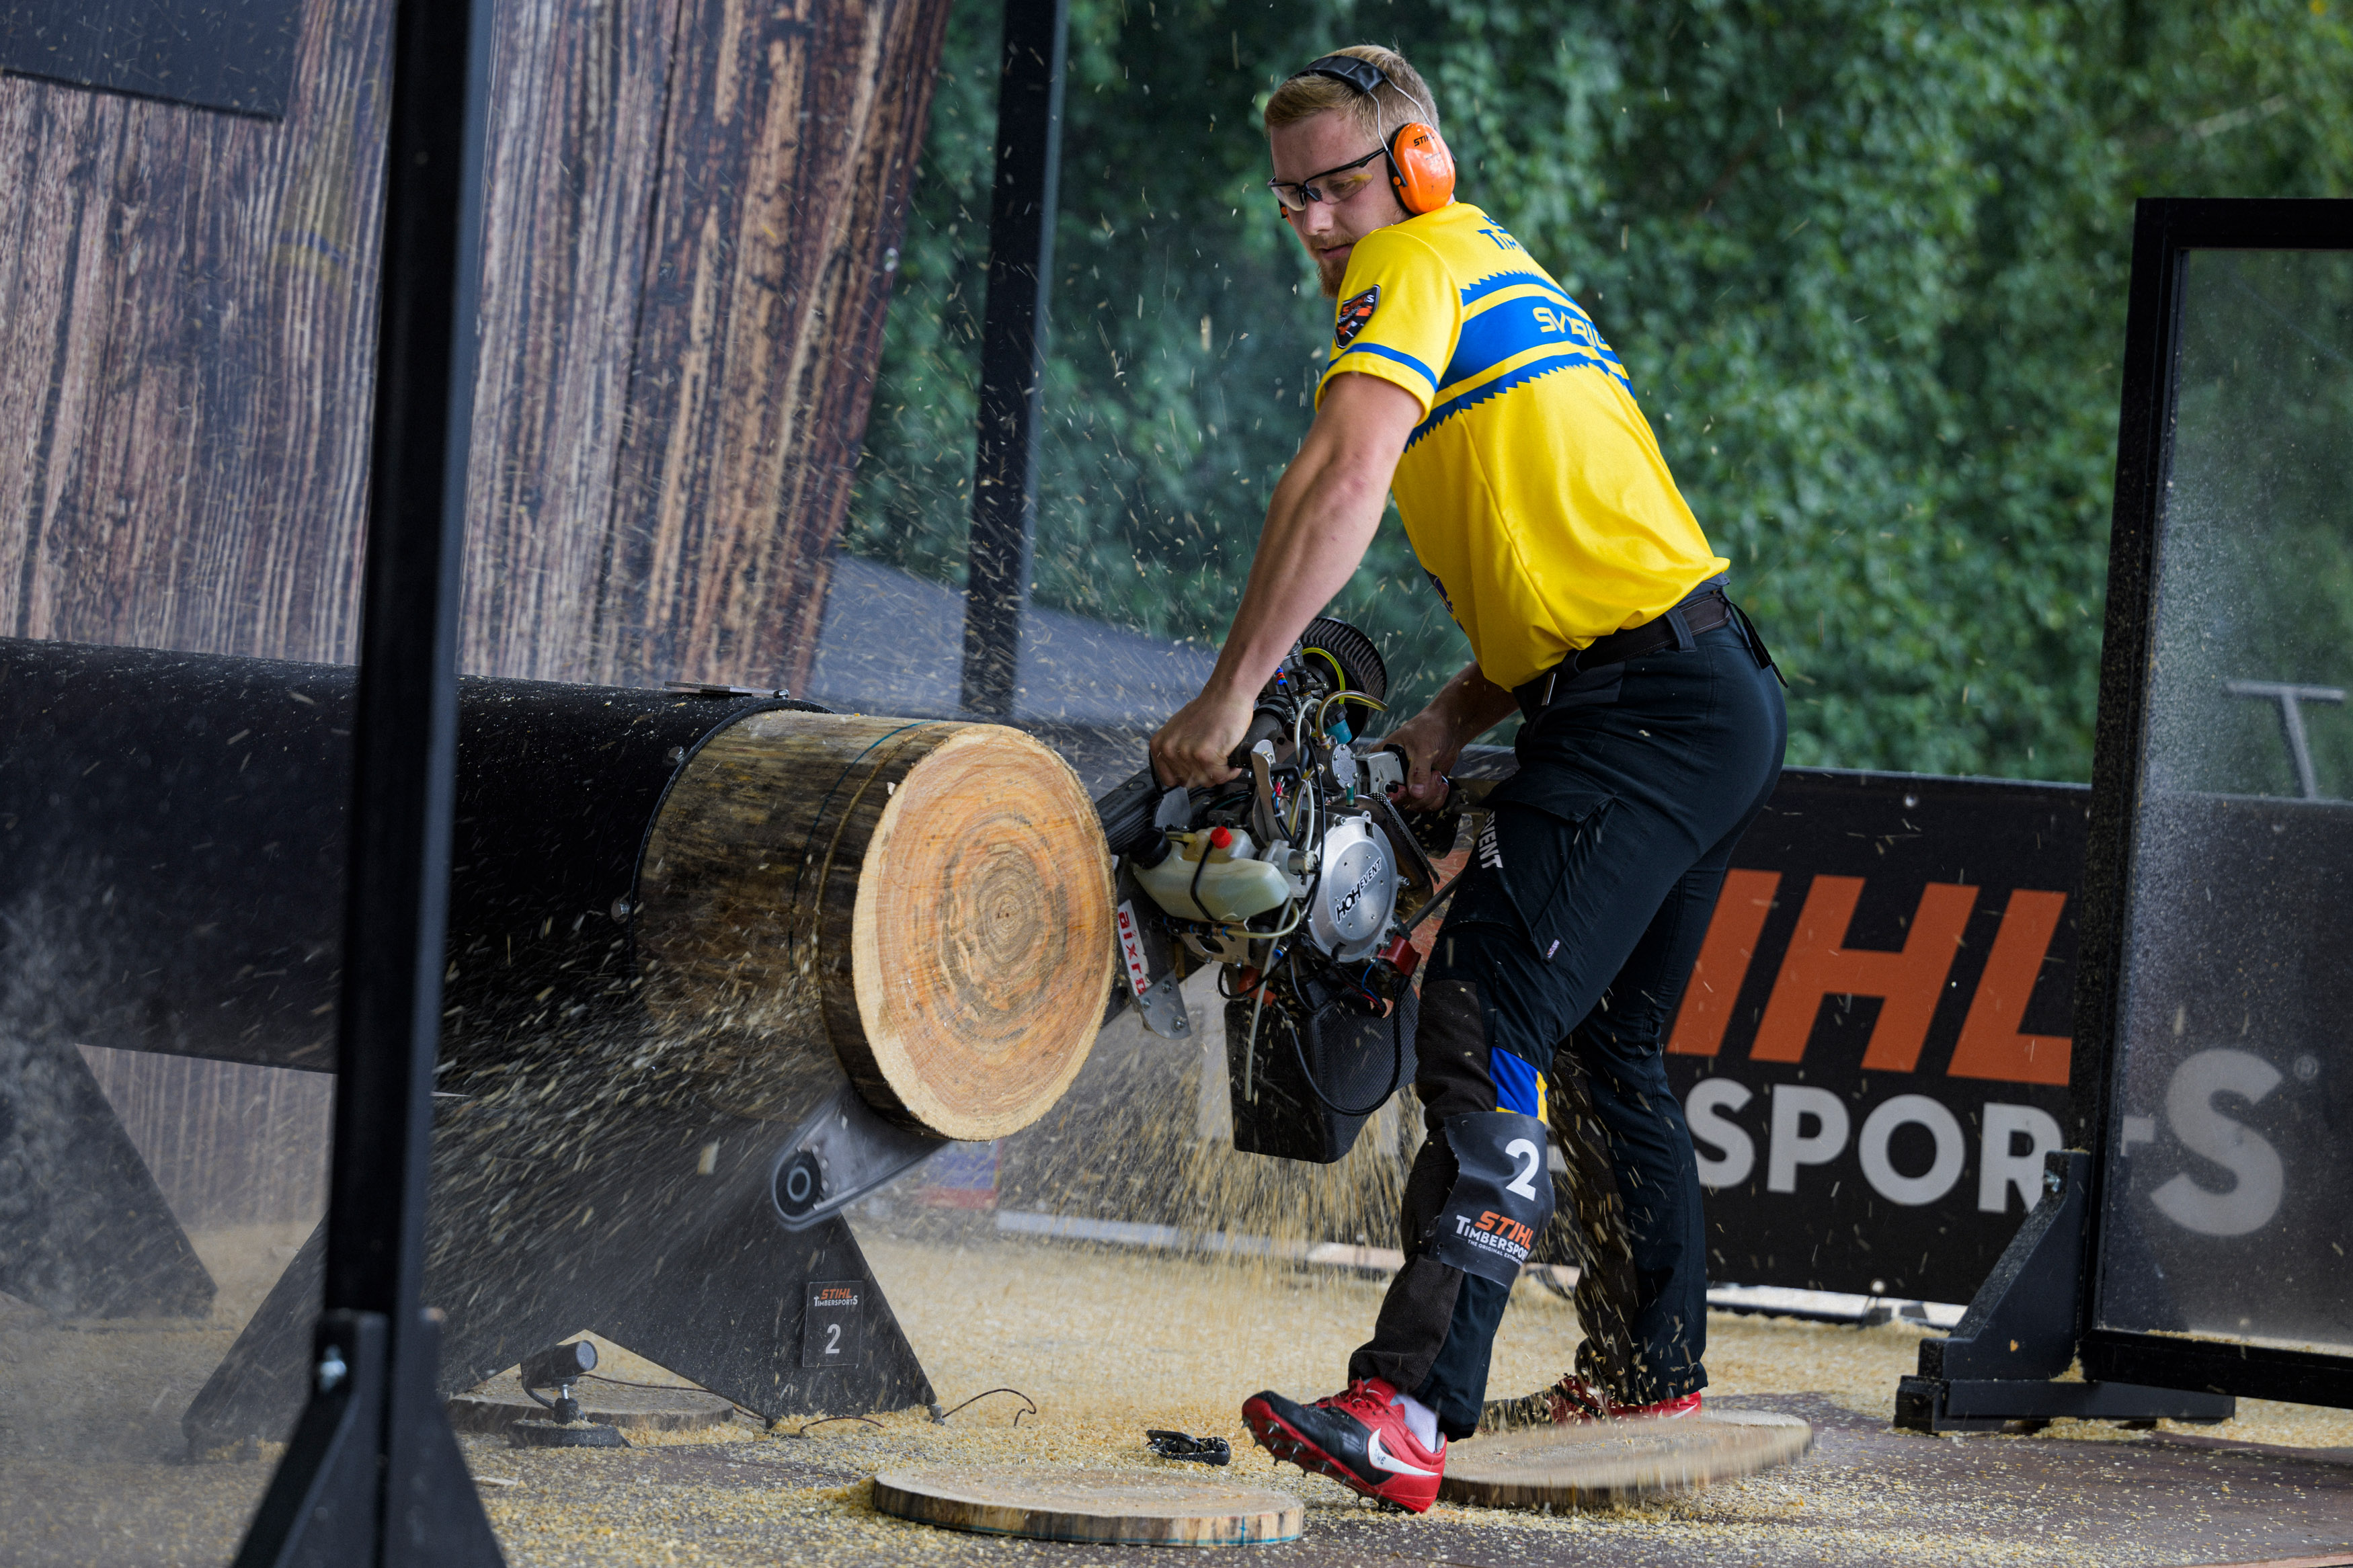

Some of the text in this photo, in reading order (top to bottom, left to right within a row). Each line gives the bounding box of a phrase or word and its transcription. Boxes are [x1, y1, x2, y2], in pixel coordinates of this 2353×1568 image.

[1505, 1138, 1540, 1202] 2
[1474, 1210, 1534, 1251] STIHL
[1468, 1239, 1478, 1247] THE
[1478, 1243, 1503, 1256] ORIGINAL
[813, 1294, 859, 1307] TIMBERSPORTS
[821, 1288, 853, 1301] STIHL
[825, 1323, 841, 1355] 2
